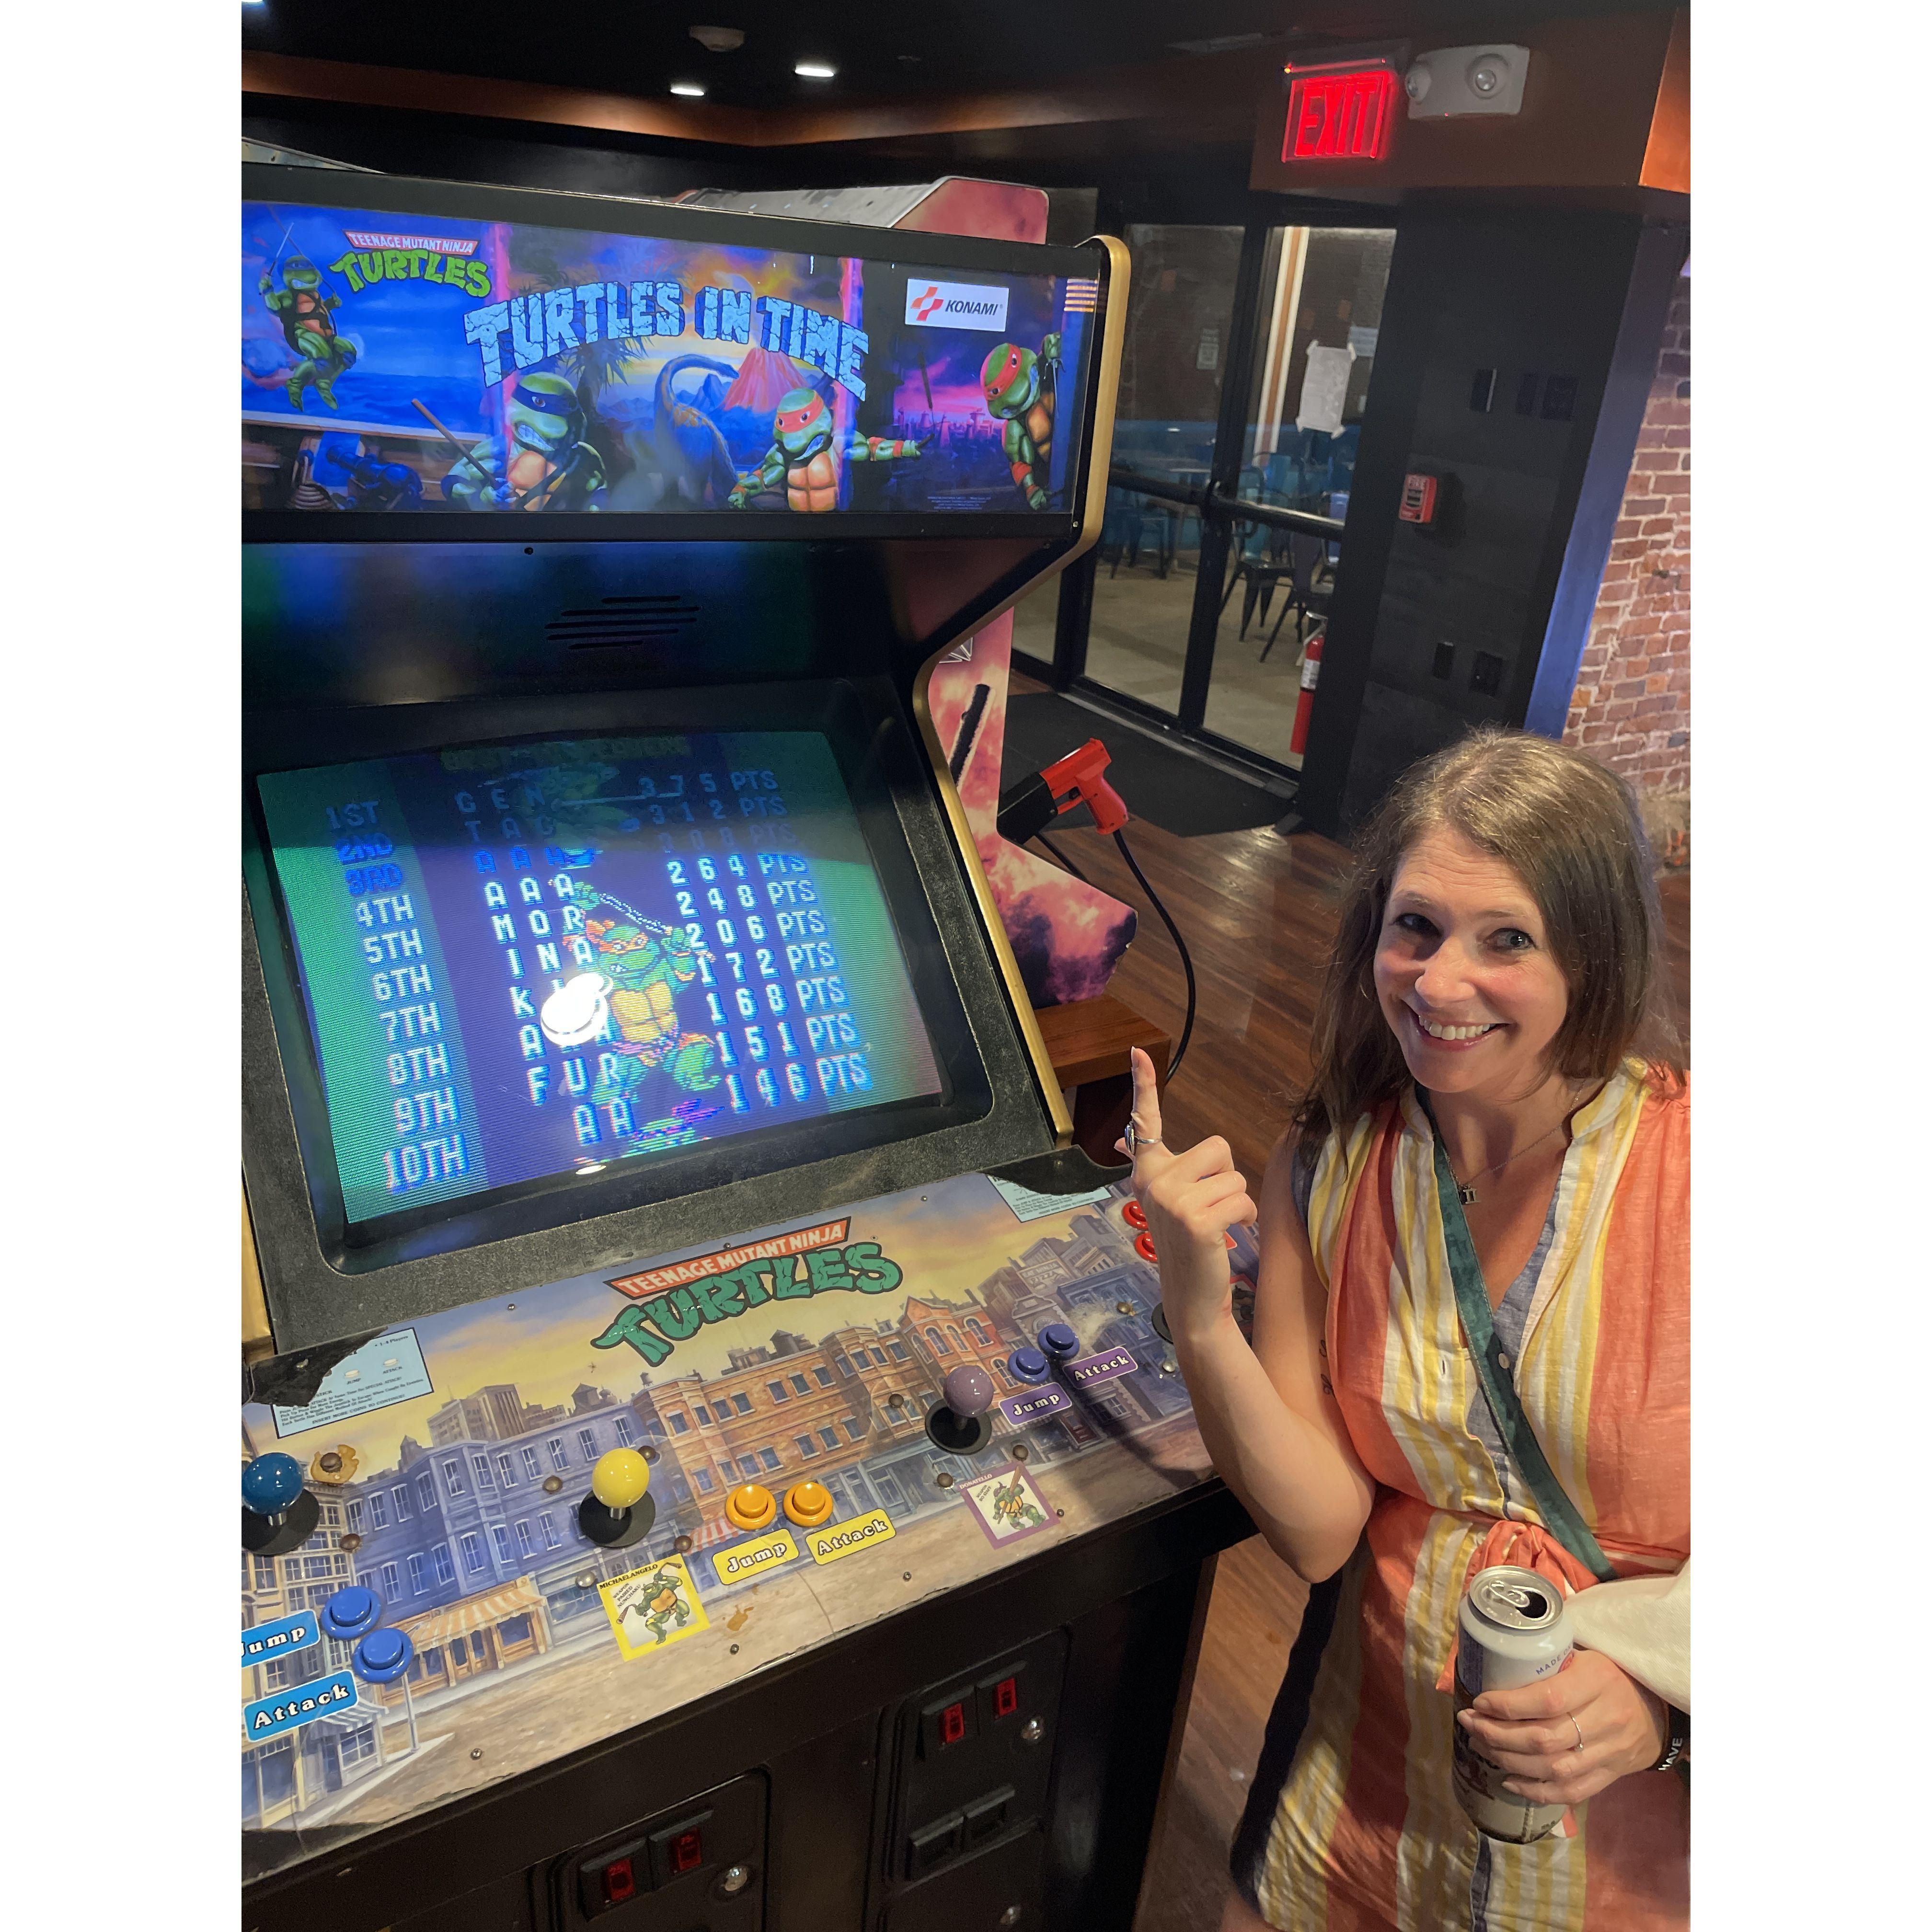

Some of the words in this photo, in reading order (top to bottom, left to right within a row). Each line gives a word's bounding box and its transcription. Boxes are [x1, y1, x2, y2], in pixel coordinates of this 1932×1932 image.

[1294, 81, 1378, 157] EXIT
[349, 233, 401, 248] TEENAGE
[402, 238, 441, 250] MUTANT
[442, 240, 473, 253] NINJA
[328, 248, 492, 298] TURTLES
[945, 299, 999, 315] KONAMI
[463, 282, 685, 388] TURTLES
[695, 286, 751, 345] IN
[757, 295, 869, 402] TIME
[326, 801, 379, 828] 1ST
[639, 773, 718, 797] 375
[730, 770, 778, 791] PTS
[337, 832, 392, 863] 2ND
[739, 797, 788, 817] PTS
[344, 863, 403, 895] 3RD
[355, 894, 416, 929] 4TH
[758, 852, 809, 876] PTS
[363, 928, 425, 966] 5TH
[767, 879, 818, 908] PTS
[371, 963, 434, 1002] 6TH
[776, 910, 828, 940] PTS
[379, 1002, 442, 1042] 7TH
[785, 942, 839, 975] PTS
[386, 1042, 452, 1090] 8TH
[794, 976, 849, 1012] PTS
[394, 1085, 461, 1136] 9TH
[805, 1012, 861, 1052] PTS
[383, 1133, 470, 1196] 10TH
[816, 1053, 873, 1097] PTS
[618, 1258, 718, 1294] TEENAGE
[719, 1241, 786, 1270] MUTANT
[789, 1224, 843, 1250] NINJA
[590, 1242, 903, 1367] TURTLES
[383, 1366, 402, 1374] ATTACK
[1073, 1354, 1130, 1381] Attack
[315, 1390, 333, 1398] STICK
[1012, 1393, 1060, 1417] Jump
[959, 1474, 992, 1489] DONATELLO
[816, 1519, 889, 1556] Attack
[726, 1541, 788, 1574] Jump
[599, 1564, 658, 1589] MICHAELANGELO
[613, 1582, 629, 1598] WEAPON
[617, 1586, 632, 1601] PAIRED
[617, 1584, 641, 1608] NUNCHAKU
[1536, 1655, 1561, 1675] MADE
[253, 1683, 350, 1730] Attack
[1658, 1738, 1683, 1771] HAVE
